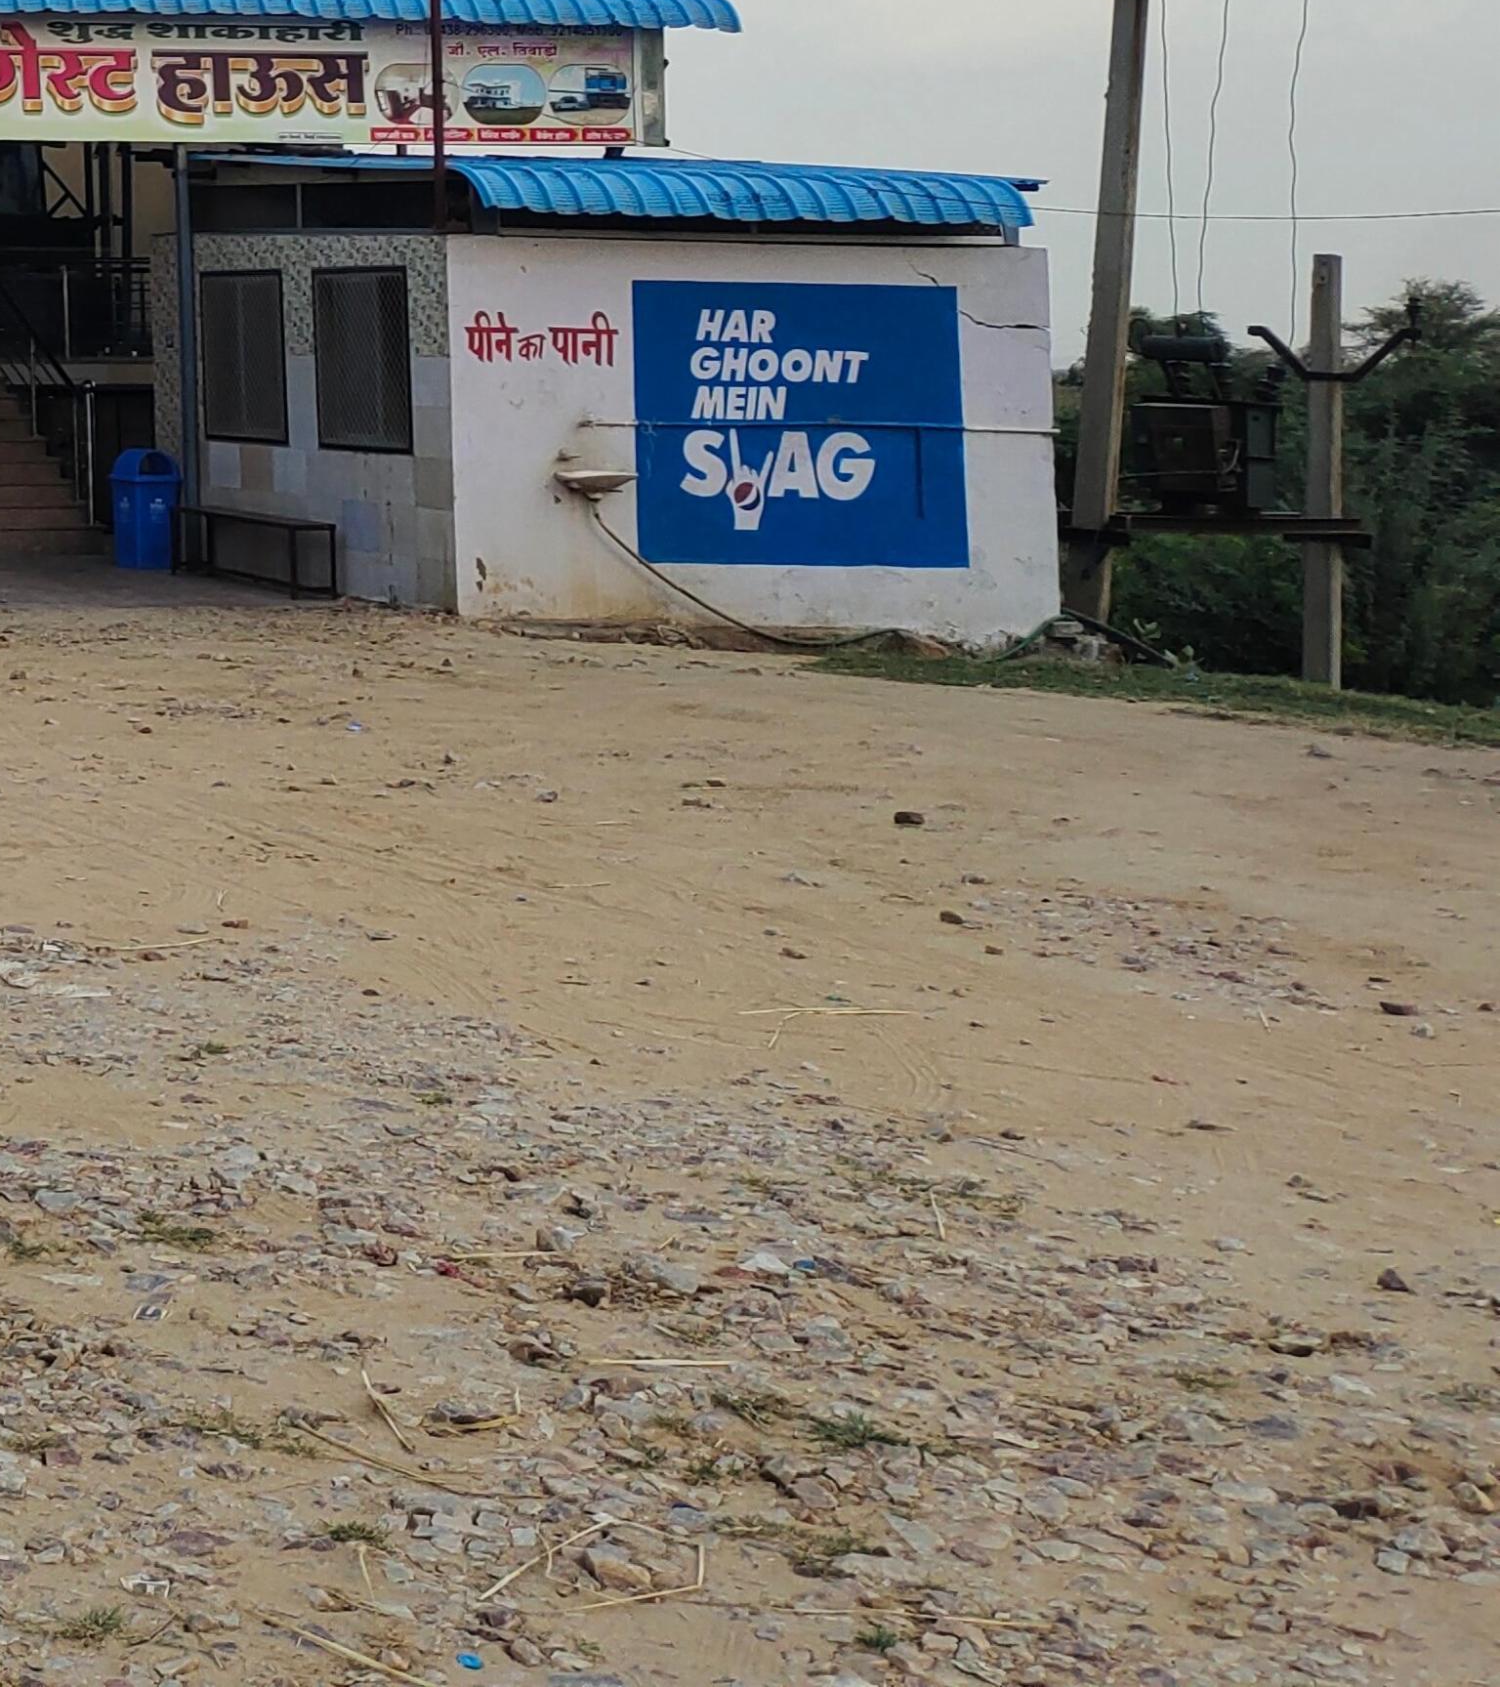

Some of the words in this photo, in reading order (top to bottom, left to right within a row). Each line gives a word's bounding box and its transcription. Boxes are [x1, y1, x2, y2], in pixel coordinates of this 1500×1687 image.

[146, 20, 365, 43] शाकाहारी
[150, 48, 370, 126] हाऊस
[464, 311, 519, 363] पीने
[517, 333, 547, 361] का
[548, 311, 619, 367] पानी
[695, 309, 777, 344] HAR
[690, 346, 870, 384] GHOONT
[690, 385, 788, 421] MEIN
